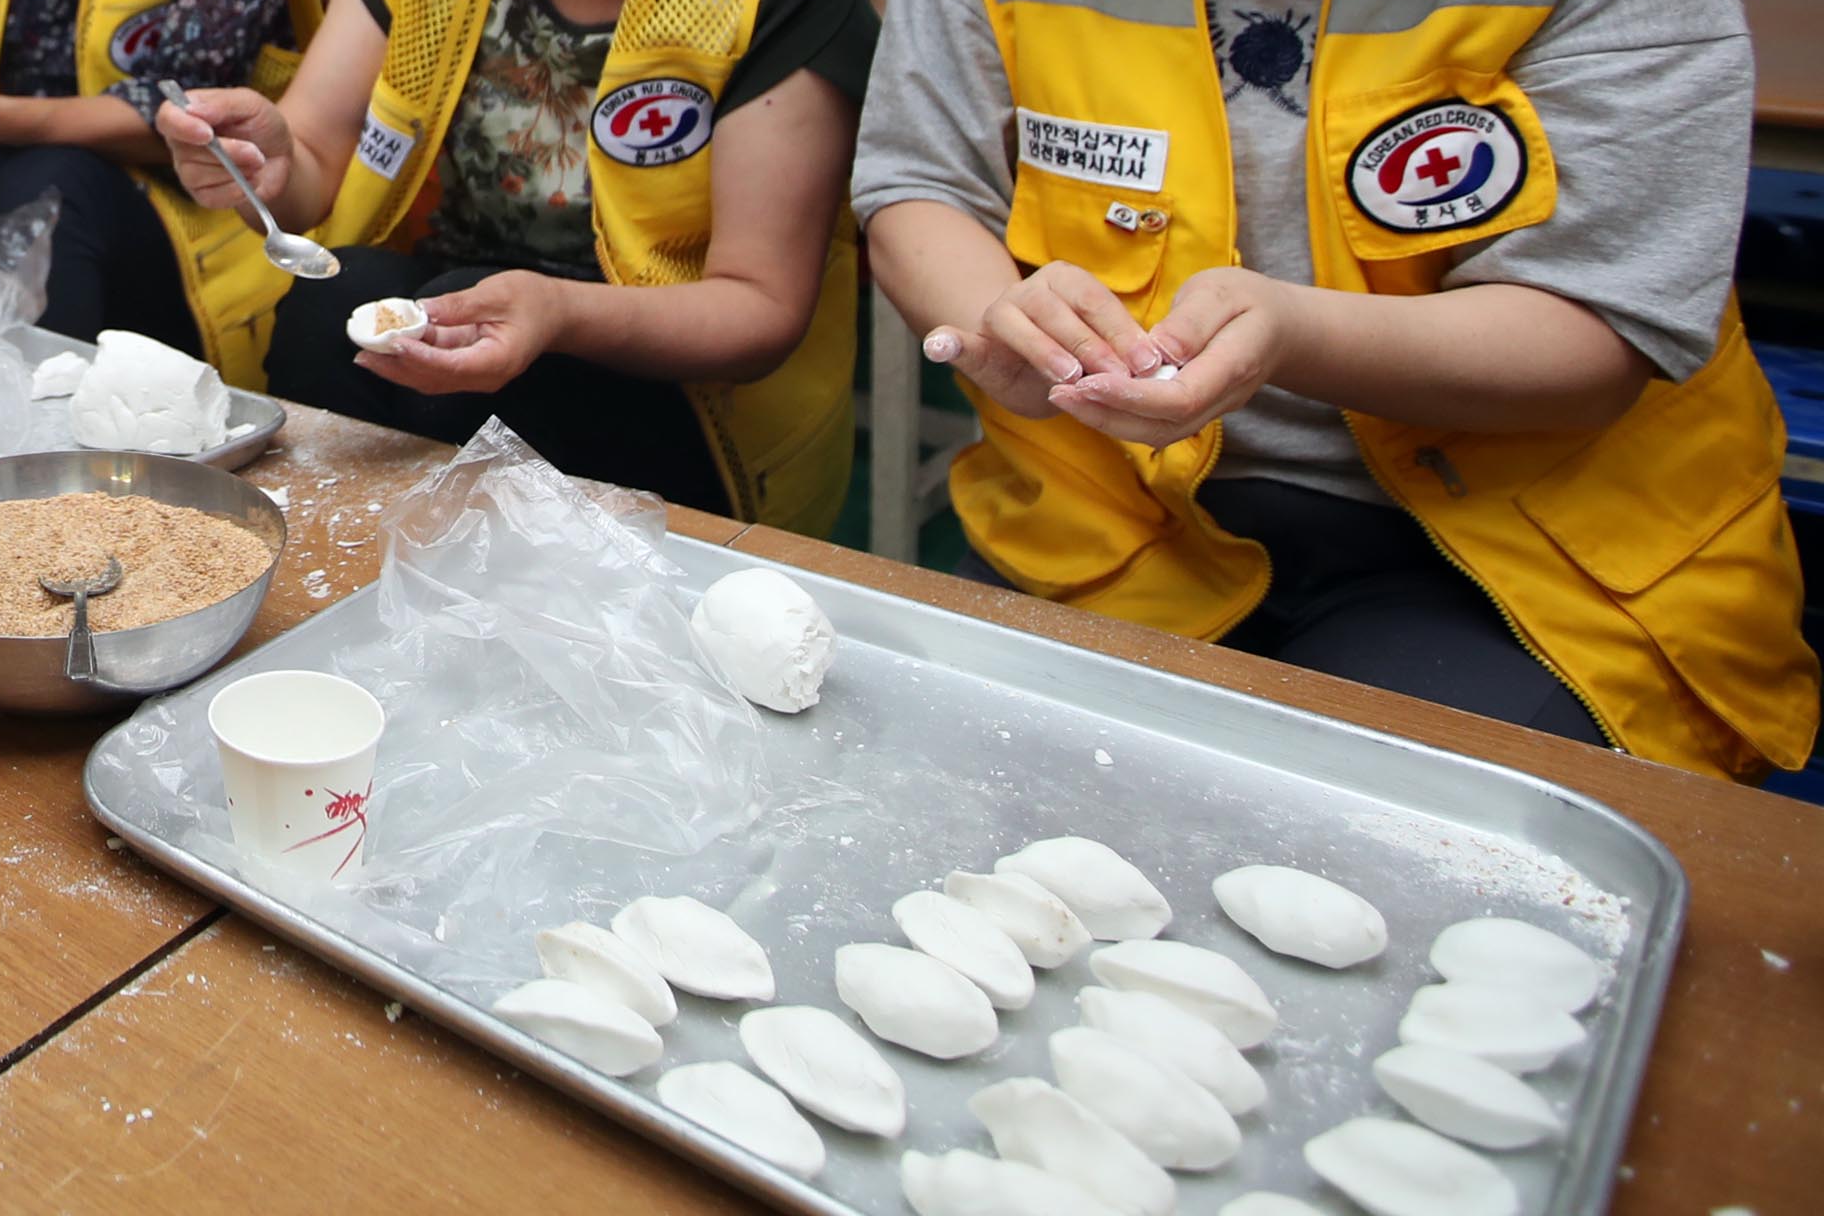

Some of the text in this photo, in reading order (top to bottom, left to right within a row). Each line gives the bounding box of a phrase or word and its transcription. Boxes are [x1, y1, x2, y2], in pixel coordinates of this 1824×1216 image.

[599, 83, 707, 118] KOREAN RED CROSS
[1026, 118, 1151, 158] 대한적십자사
[1359, 109, 1497, 172] KOREAN RED CROSS
[1029, 140, 1147, 180] 인천광역시지사
[1414, 193, 1487, 226] 봉사원
